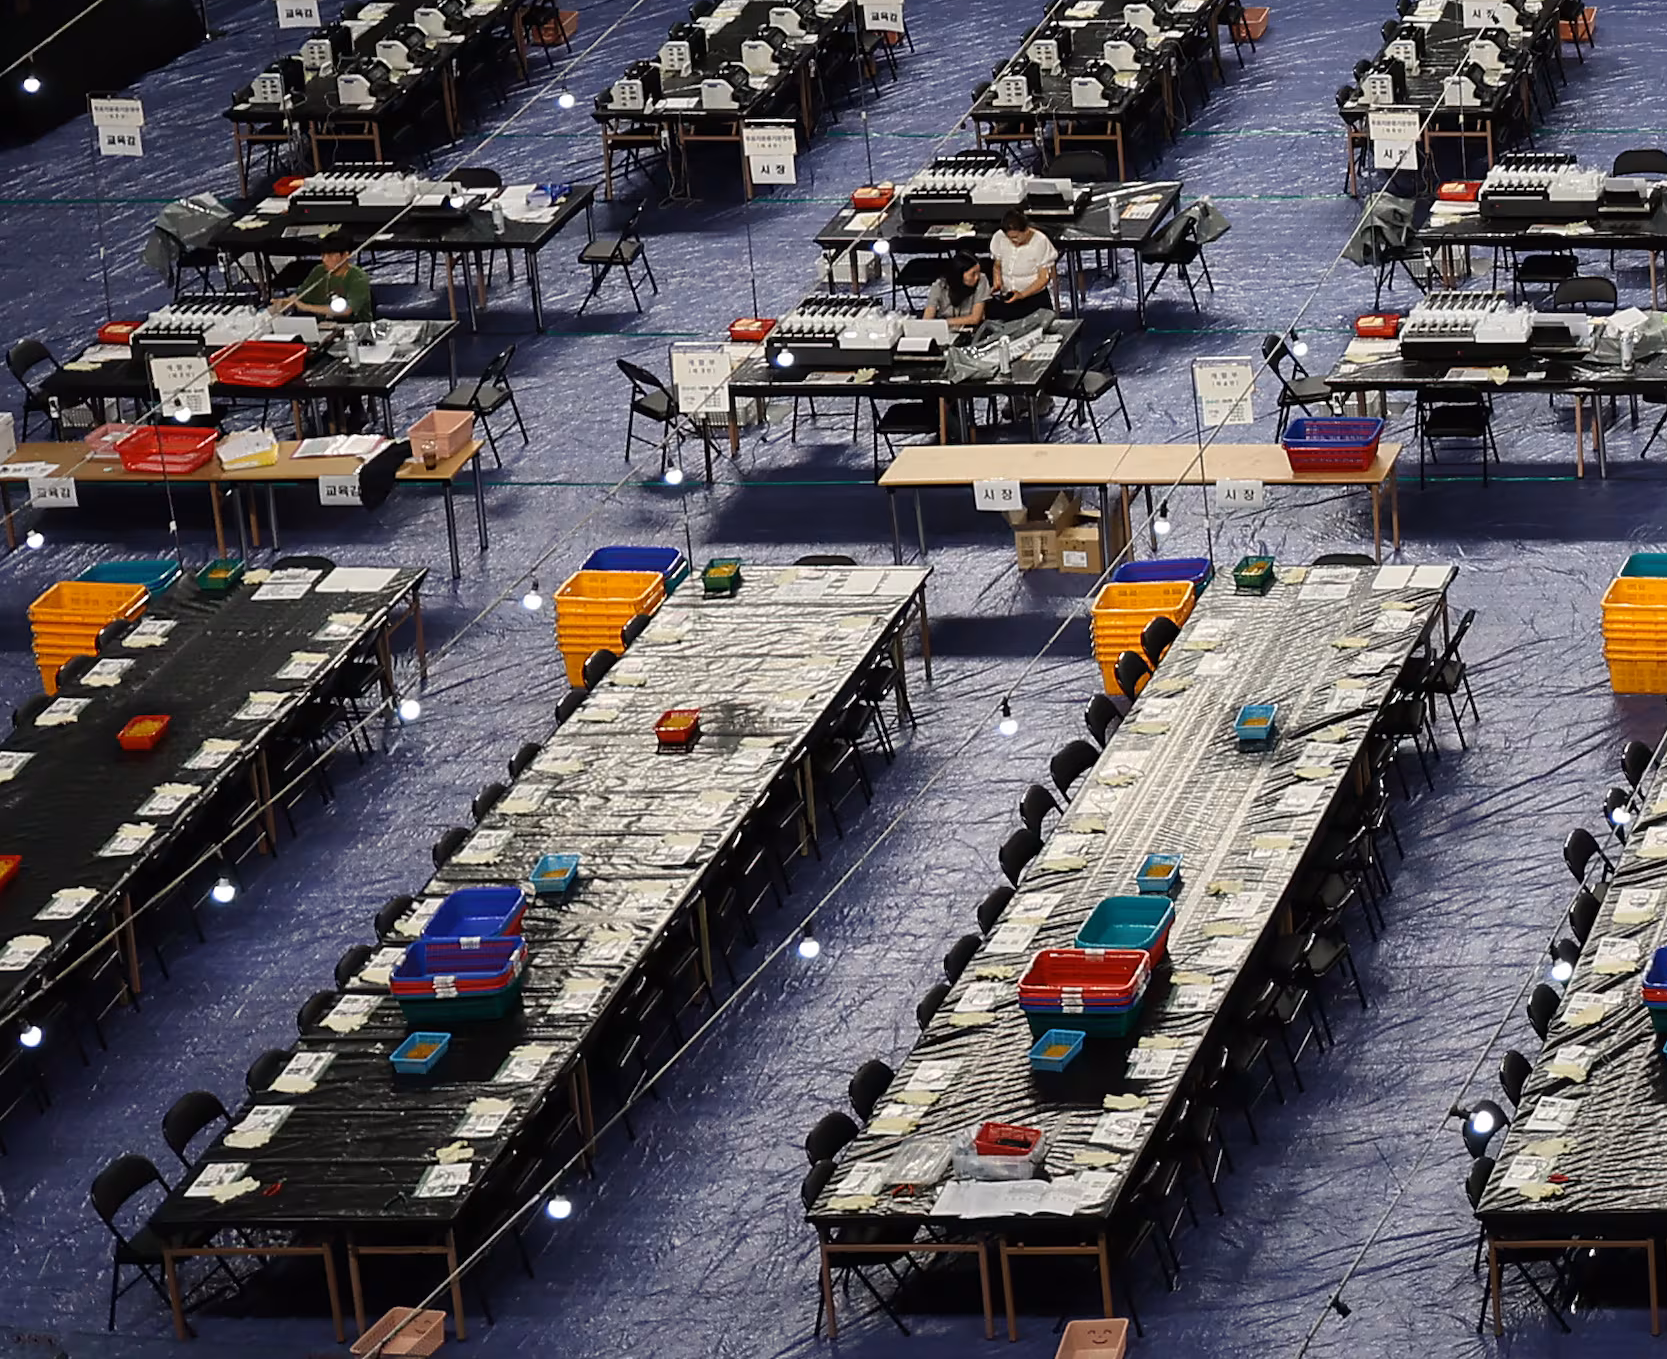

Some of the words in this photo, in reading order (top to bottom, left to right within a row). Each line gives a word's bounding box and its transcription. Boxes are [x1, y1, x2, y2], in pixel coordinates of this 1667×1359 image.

[37, 487, 71, 499] 교육감
[984, 489, 1012, 501] 시장
[1225, 489, 1254, 501] 시장
